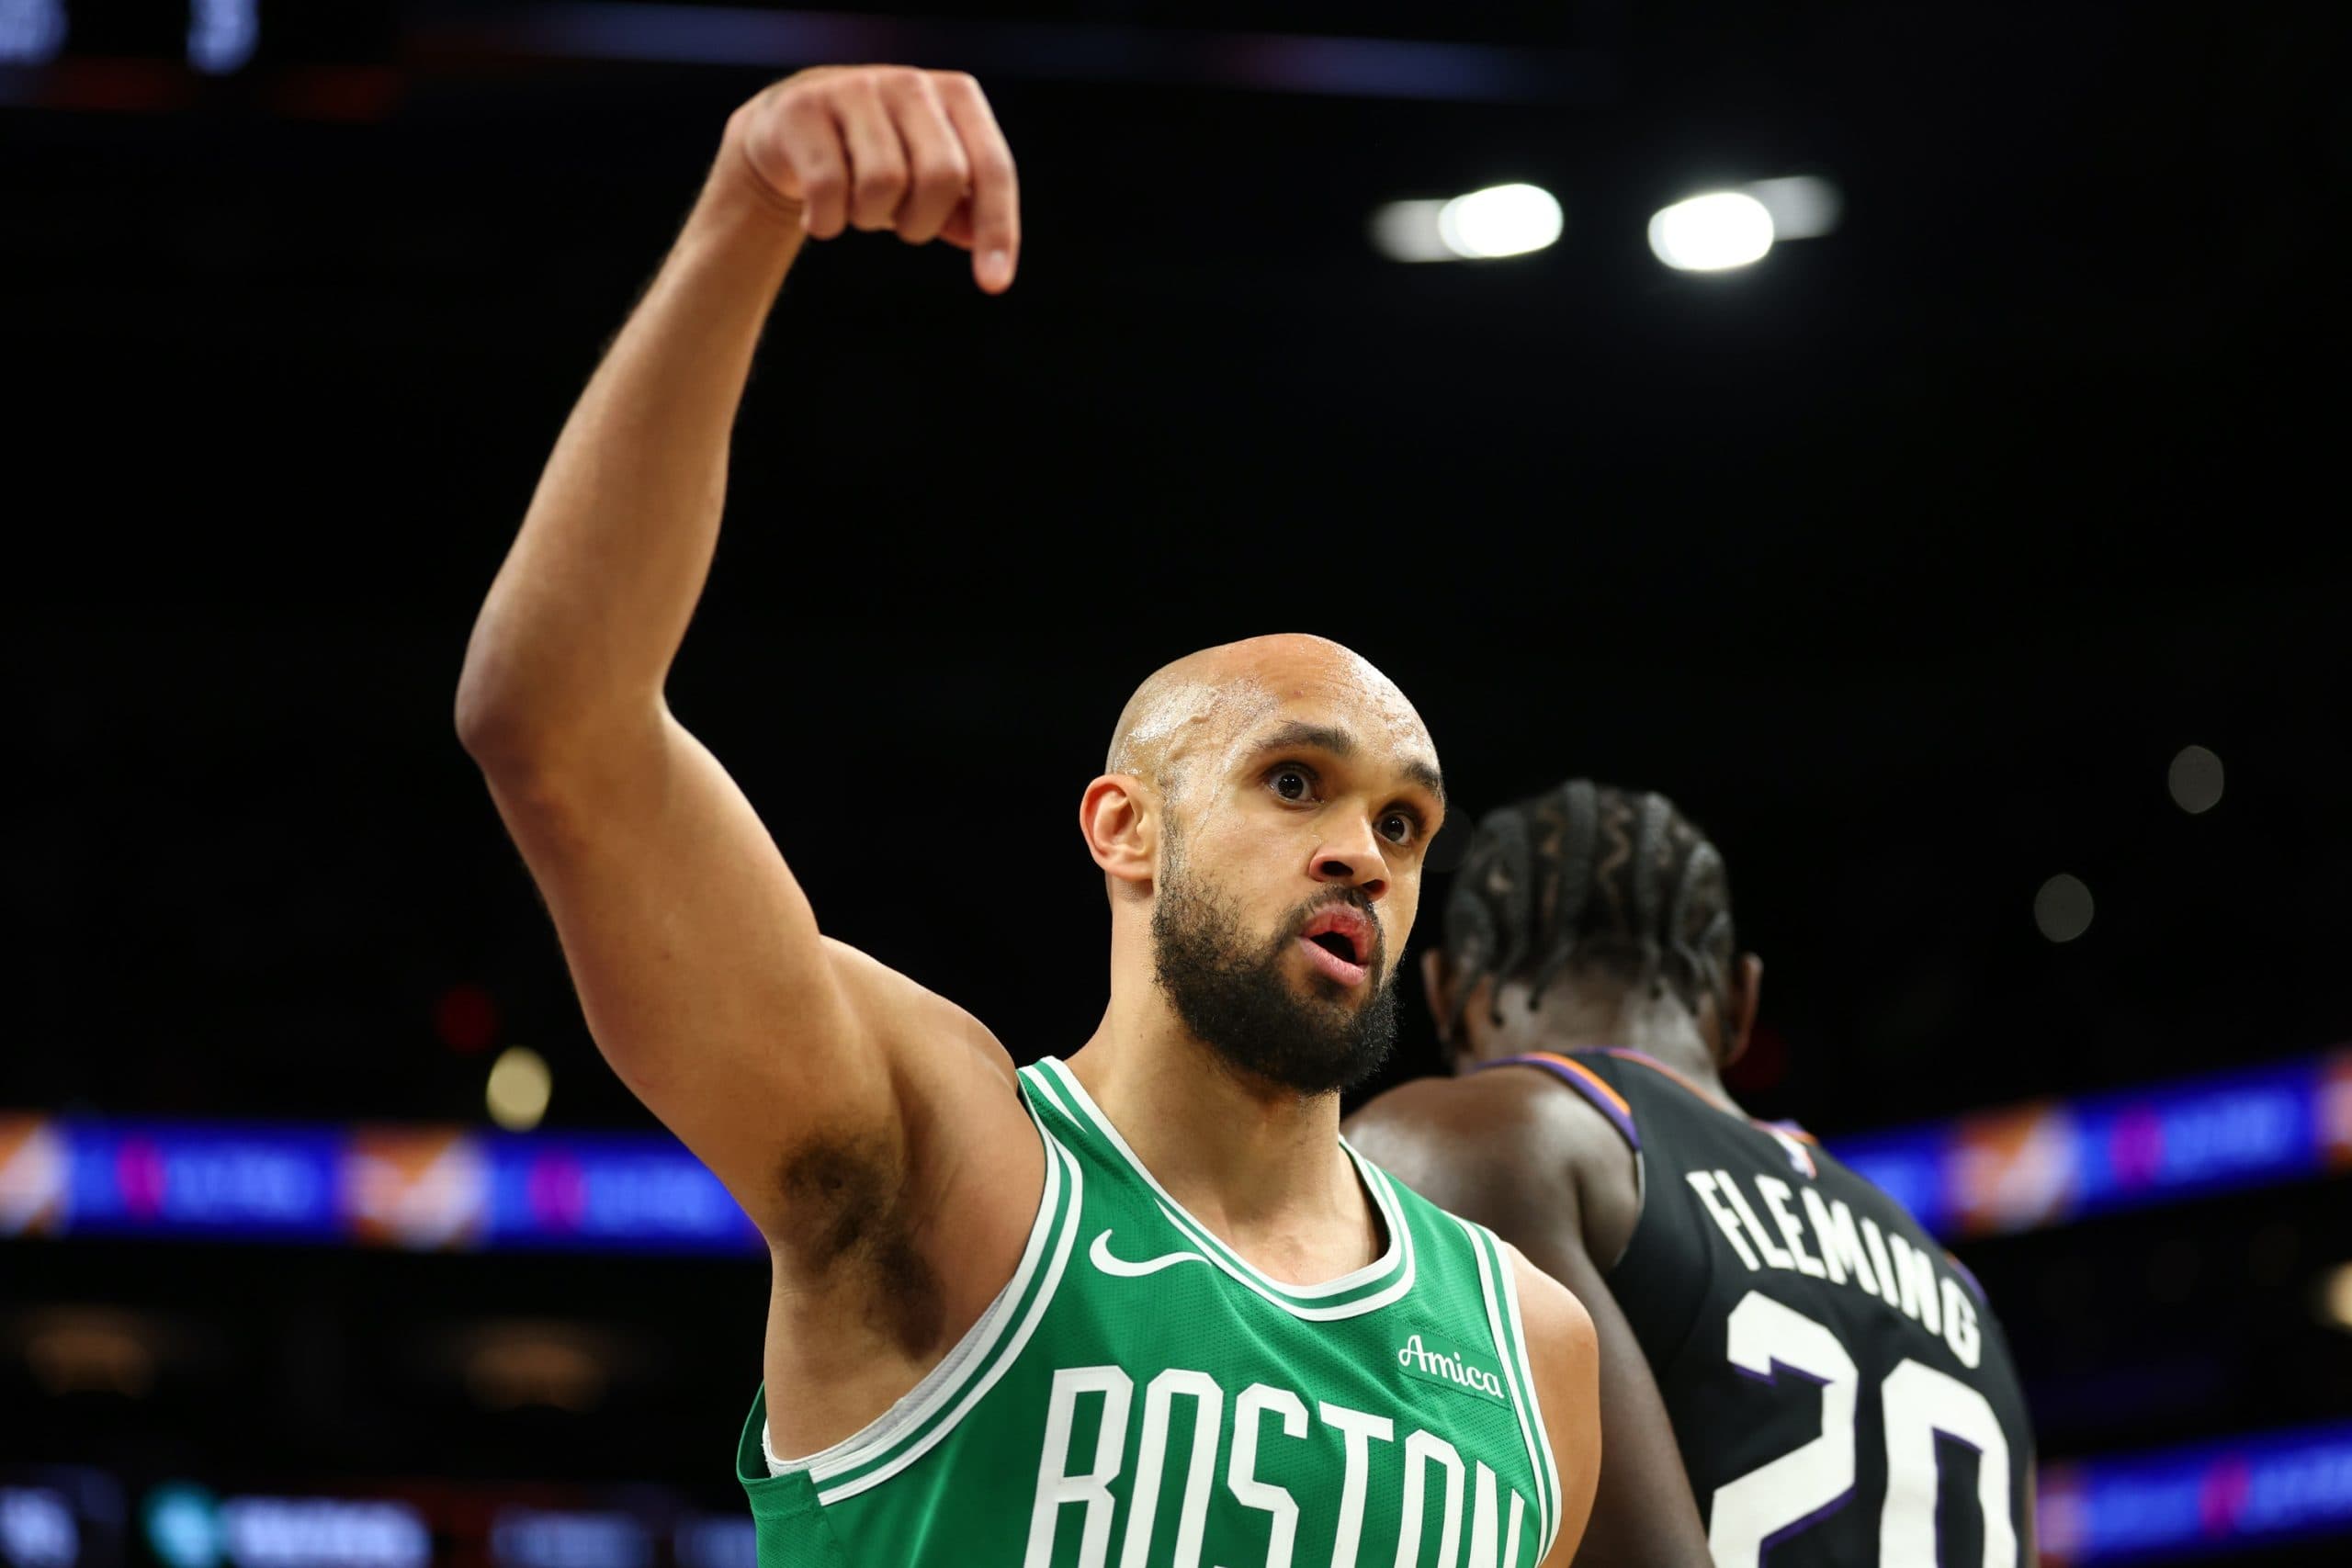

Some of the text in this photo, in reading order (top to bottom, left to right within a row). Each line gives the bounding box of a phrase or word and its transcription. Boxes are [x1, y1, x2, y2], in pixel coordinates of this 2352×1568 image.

[1397, 1335, 1505, 1400] Amica
[1686, 1169, 1981, 1370] FLEMING
[1708, 1290, 2018, 1568] 20
